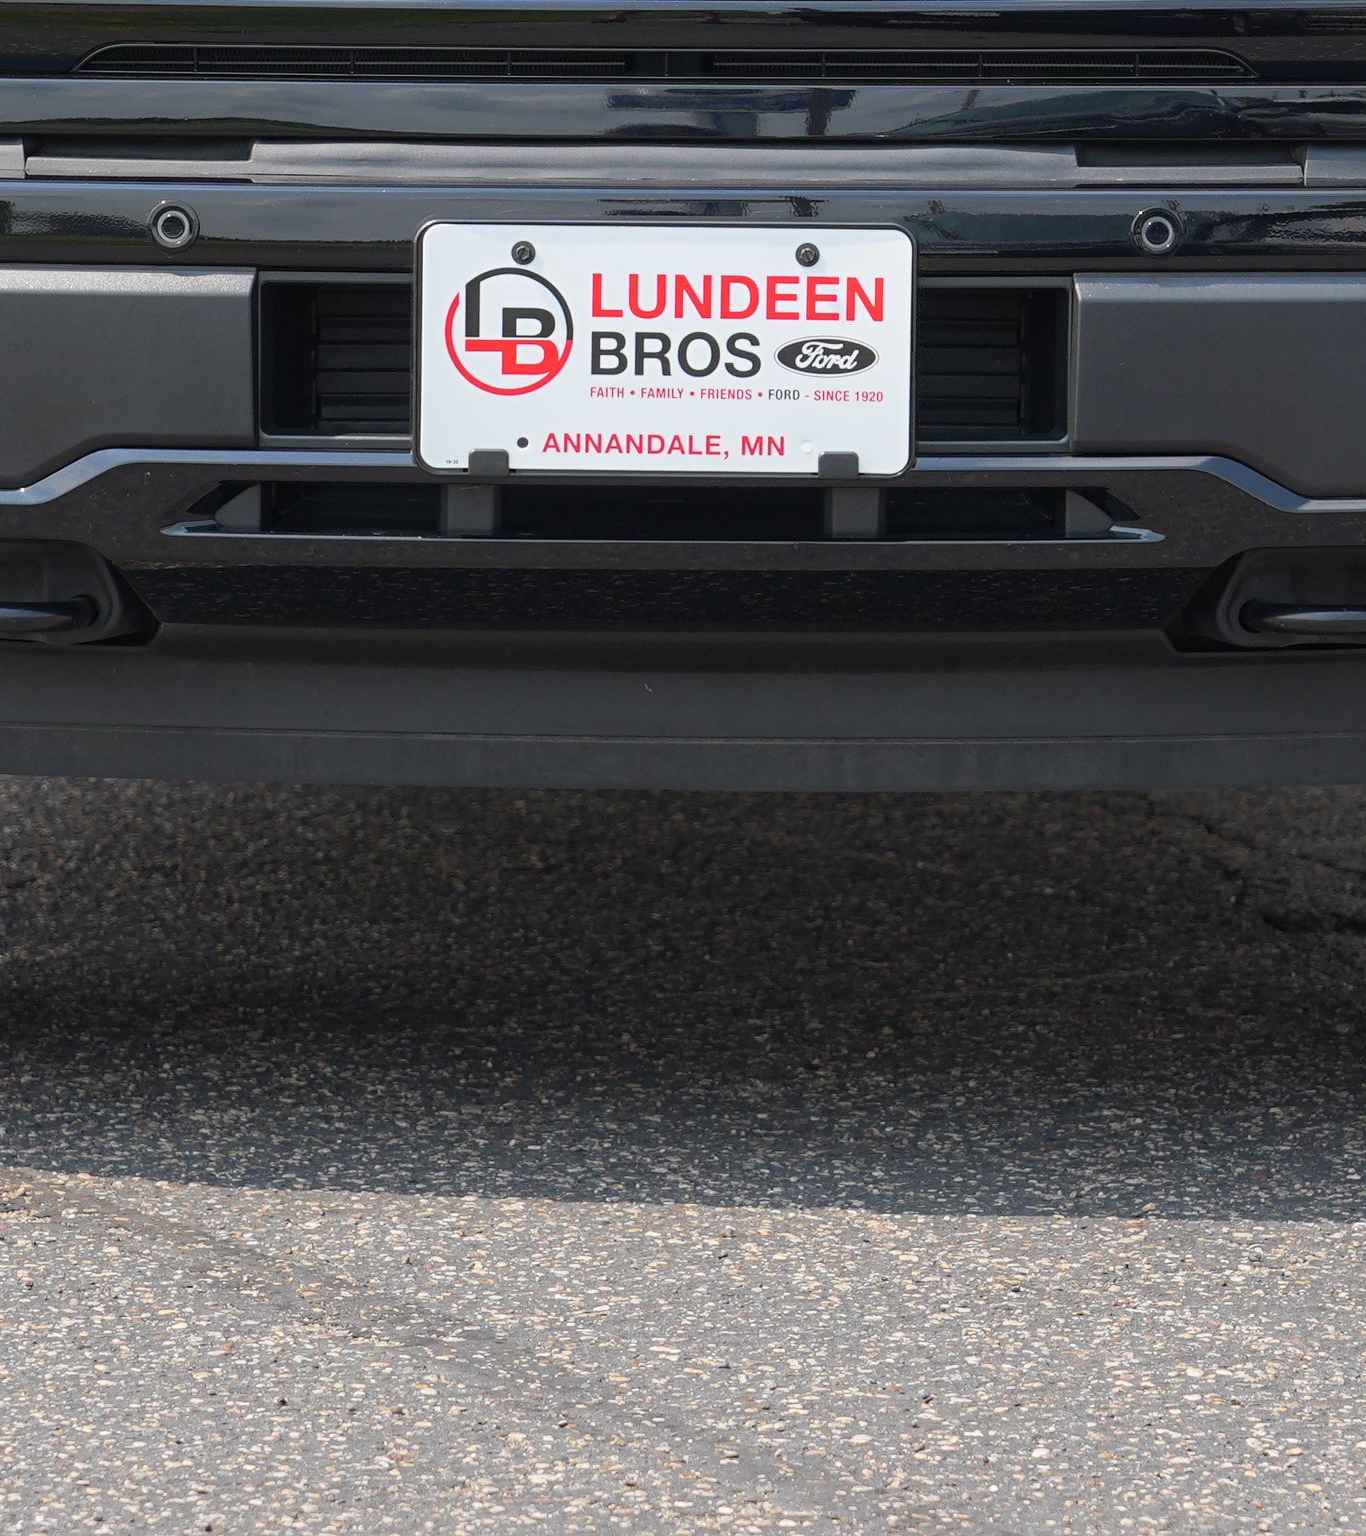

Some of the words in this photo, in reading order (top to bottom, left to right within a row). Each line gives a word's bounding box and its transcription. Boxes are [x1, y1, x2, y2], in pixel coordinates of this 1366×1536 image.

[591, 273, 884, 322] LUNDEEN
[590, 331, 761, 378] BROS
[794, 343, 859, 371] Ford
[590, 386, 625, 399] FAITH
[640, 387, 685, 400] FAMILY
[700, 388, 753, 401] FRIENDS
[768, 388, 801, 401] FORD
[814, 390, 850, 403] SINCE
[854, 390, 884, 403] 1920
[542, 432, 730, 460] ANNANDALE,
[741, 435, 786, 456] MN
